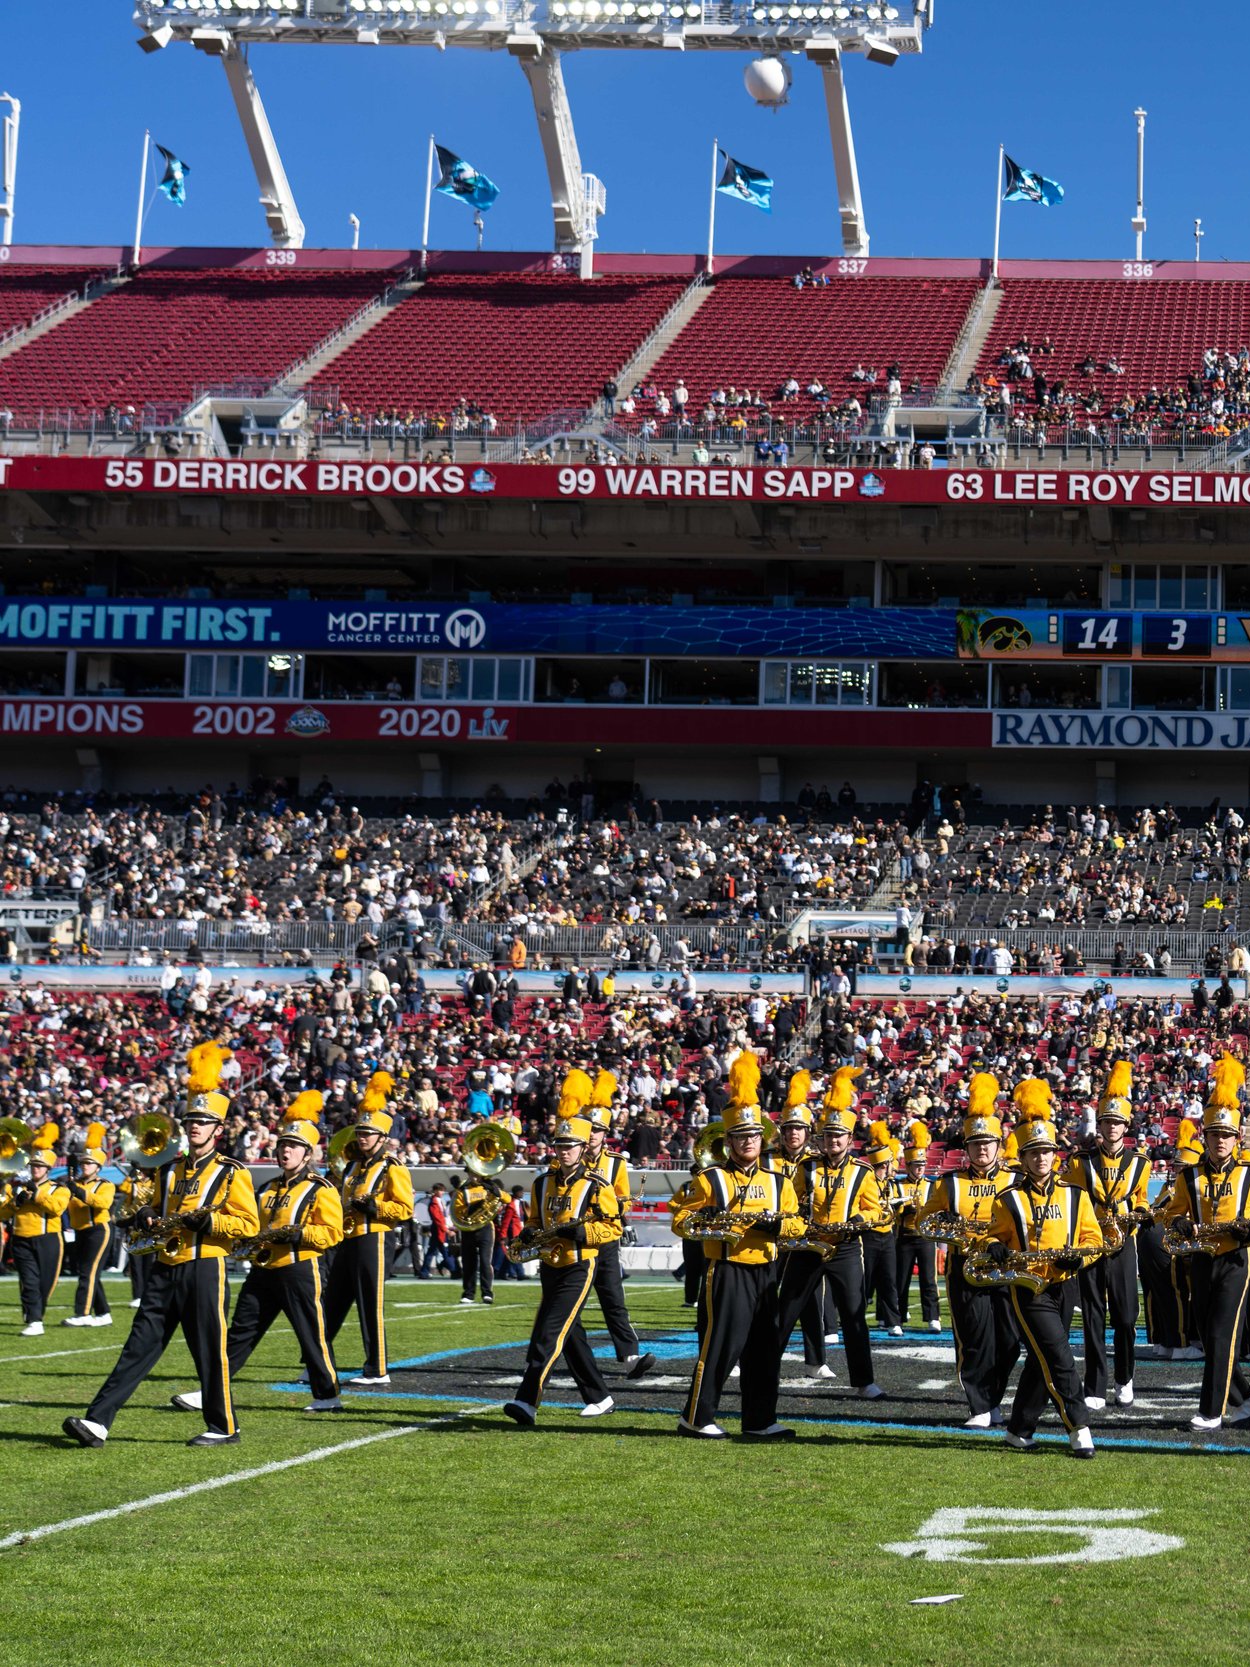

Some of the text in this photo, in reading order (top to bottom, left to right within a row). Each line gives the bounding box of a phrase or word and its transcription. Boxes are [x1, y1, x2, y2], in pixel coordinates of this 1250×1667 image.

[265, 250, 297, 265] 339
[838, 259, 868, 274] 337
[1122, 262, 1153, 278] 336
[105, 460, 466, 493] 55 DERRICK BROOKS
[558, 467, 855, 498] 99 WARREN SAPP
[946, 472, 984, 500] 63
[994, 473, 1058, 501] LEE
[1068, 474, 1141, 502] ROY
[161, 606, 281, 642] FIRST.
[327, 611, 441, 632] MOFFITT
[1077, 618, 1119, 650] 14
[1167, 618, 1187, 651] 3
[328, 633, 440, 644] CANCER CENTER
[2, 703, 144, 734] MPIONS
[193, 706, 276, 736] 2002
[379, 708, 462, 737] 2020
[995, 713, 1214, 748] RAYMOND
[969, 1185, 997, 1198] IOWA
[882, 1507, 1184, 1564] 5
